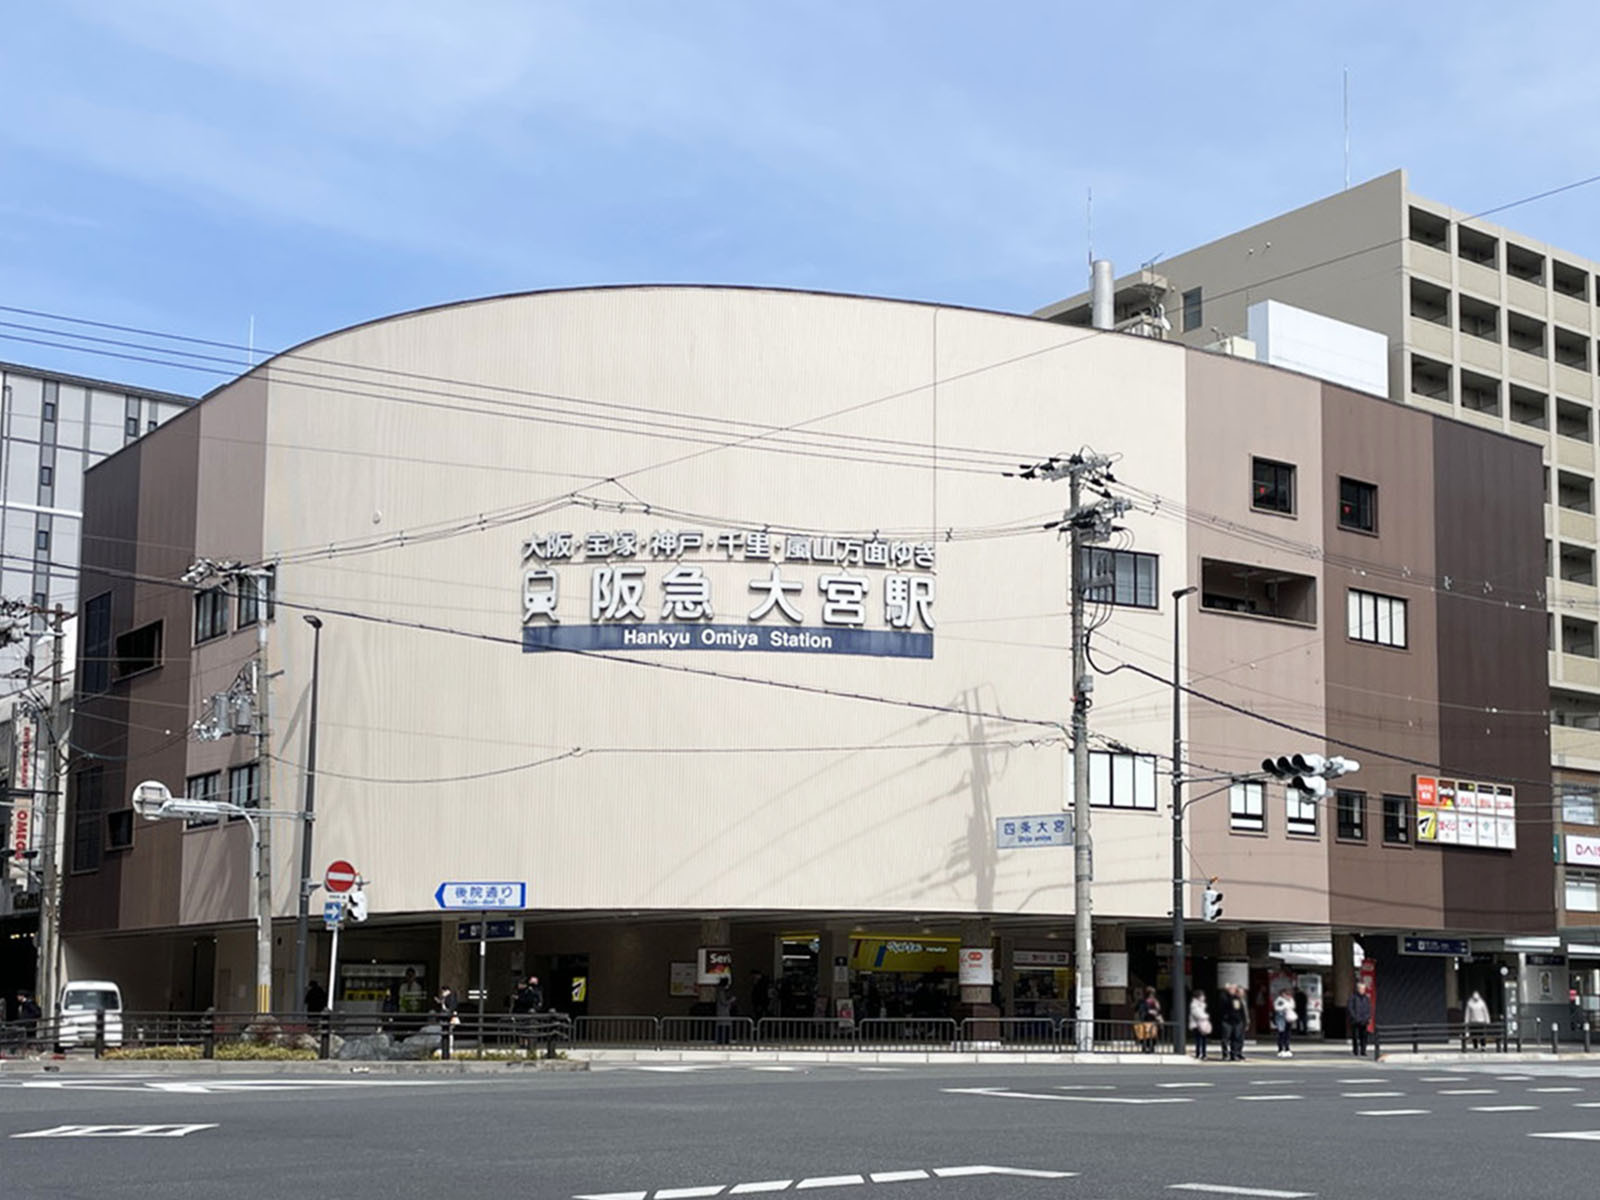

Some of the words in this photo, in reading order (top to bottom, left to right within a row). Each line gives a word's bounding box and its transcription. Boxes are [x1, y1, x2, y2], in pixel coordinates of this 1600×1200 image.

[592, 565, 713, 620] 阪急
[749, 567, 935, 629] 大宮駅
[624, 629, 691, 648] Hankyu
[701, 629, 759, 648] Omiya
[770, 631, 832, 648] Station
